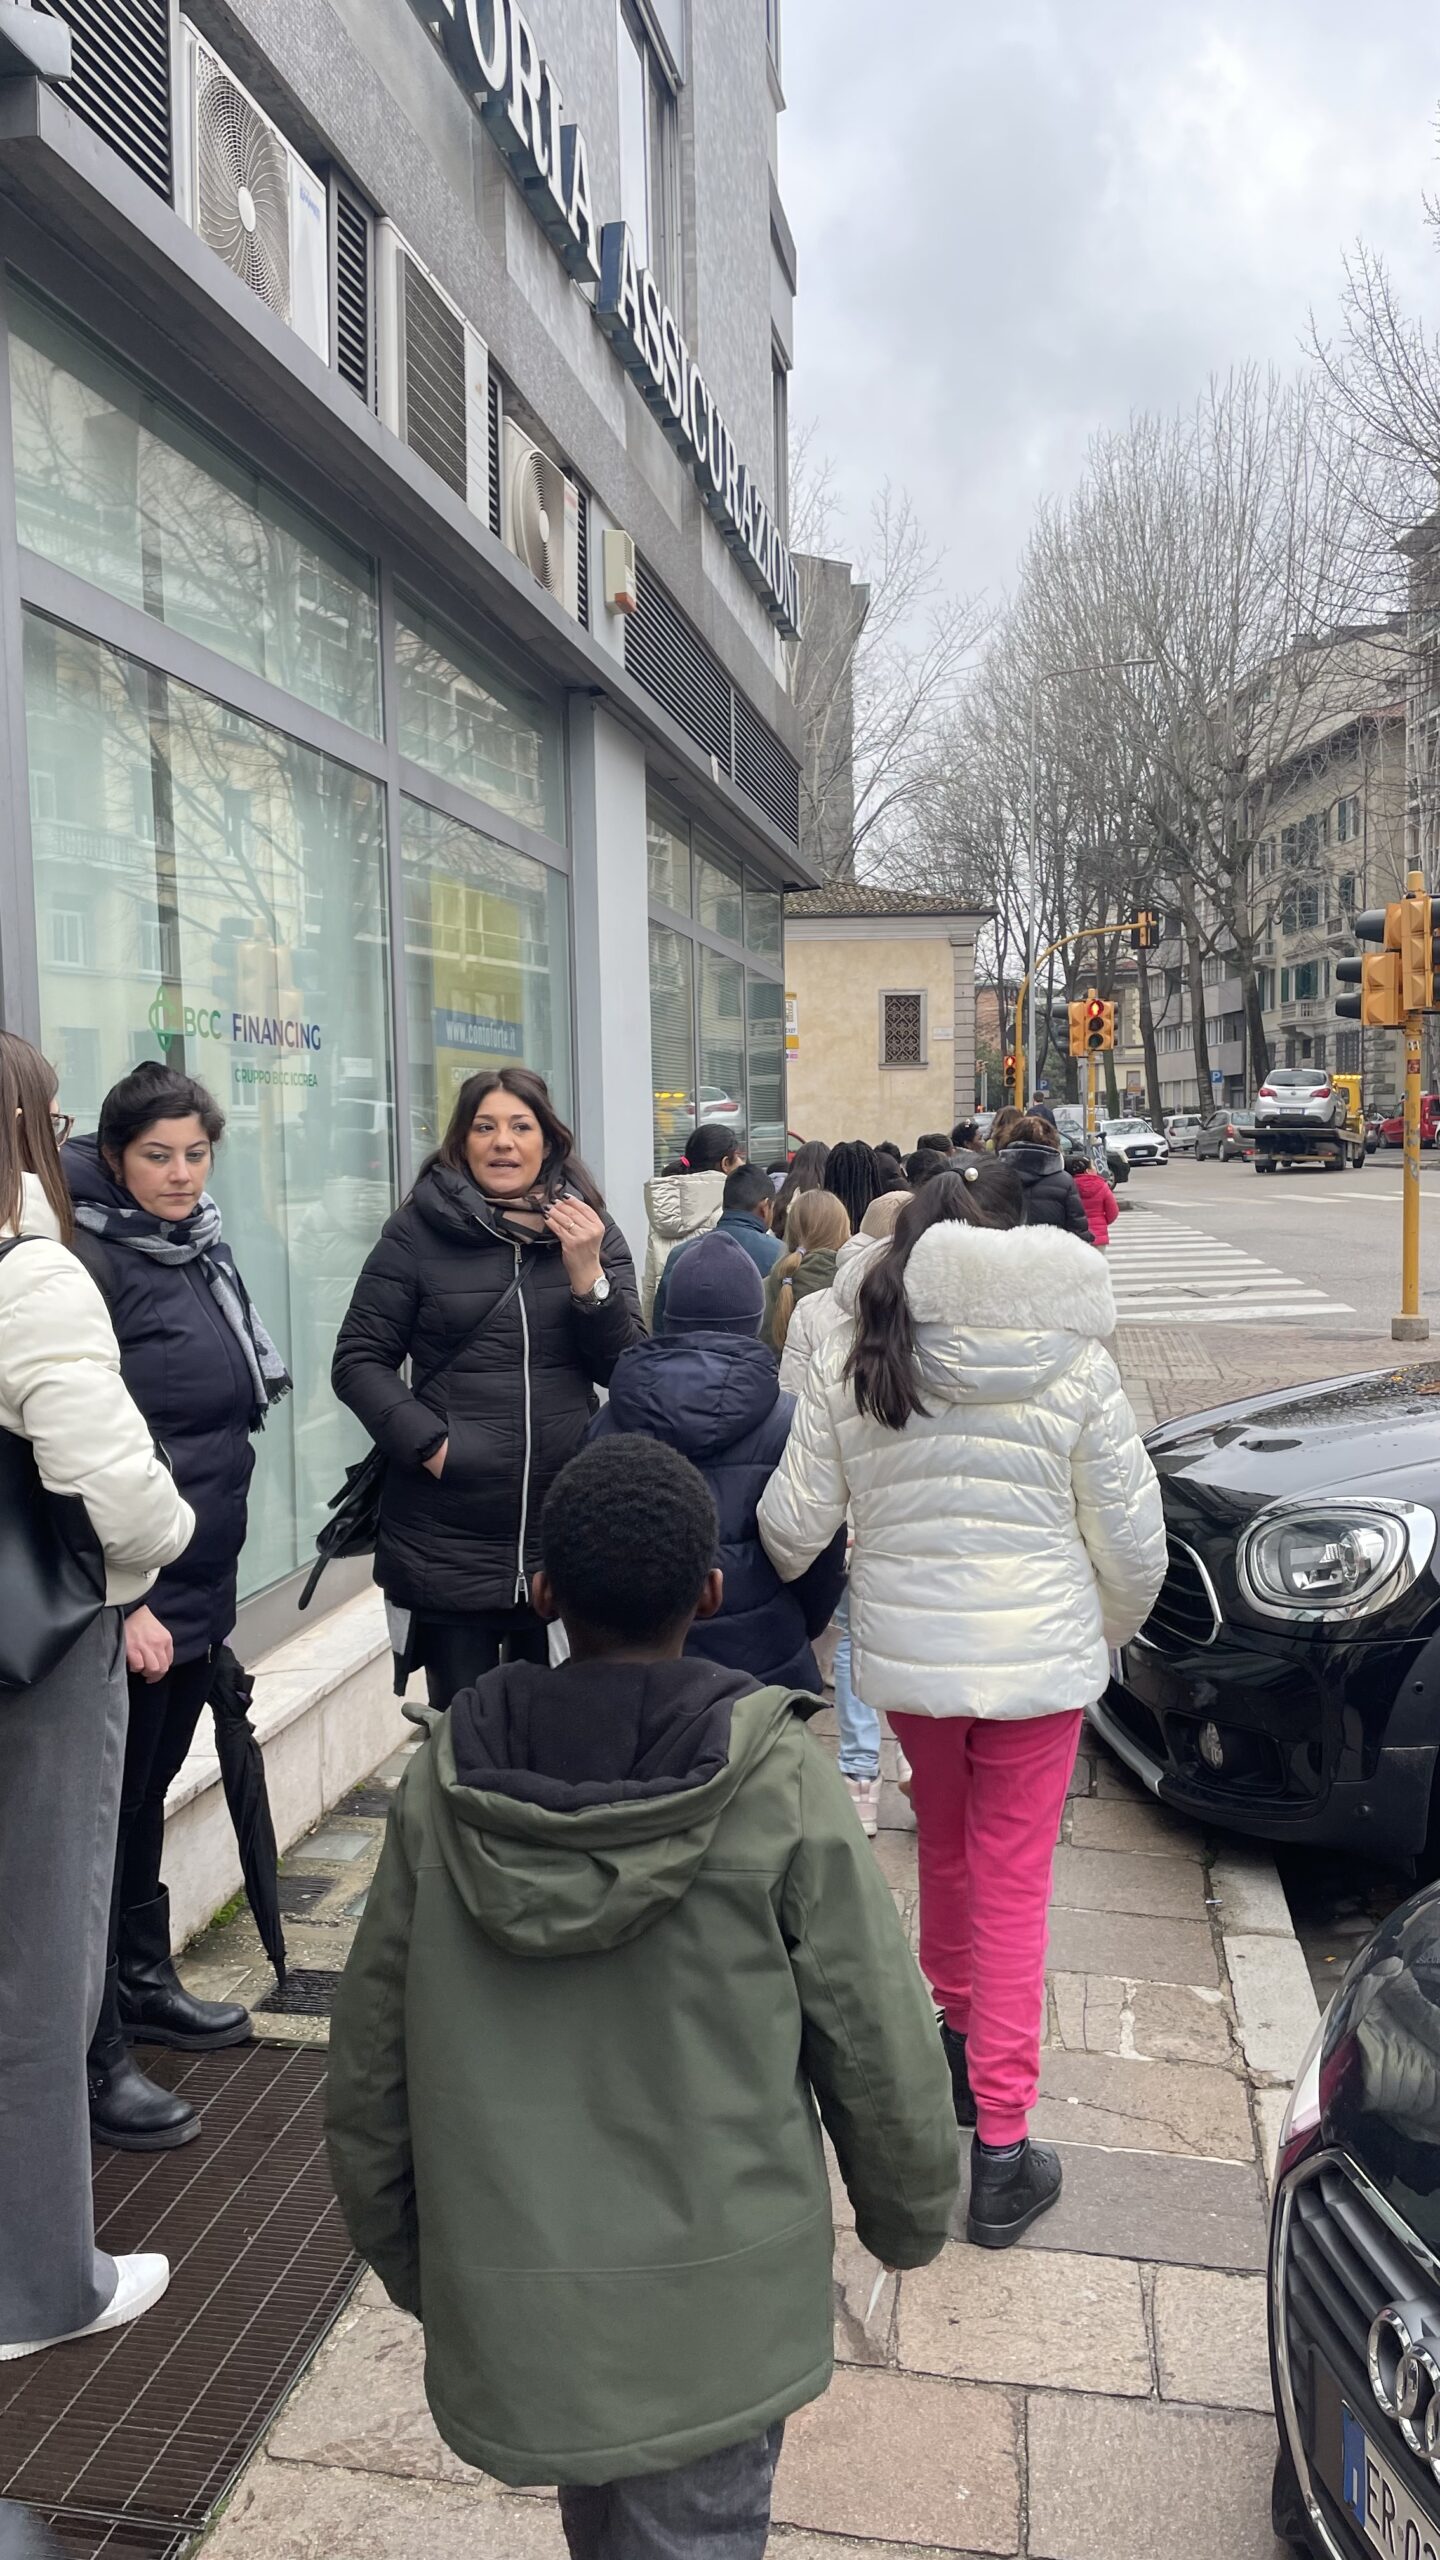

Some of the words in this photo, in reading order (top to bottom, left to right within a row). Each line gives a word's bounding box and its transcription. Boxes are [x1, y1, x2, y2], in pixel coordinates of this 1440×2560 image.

[442, 0, 601, 281] ORIA
[617, 221, 802, 641] ASSICURAZIONI
[184, 1006, 222, 1040] BCC
[232, 1012, 322, 1051] FINANCING
[234, 1068, 271, 1084] GRUPPO
